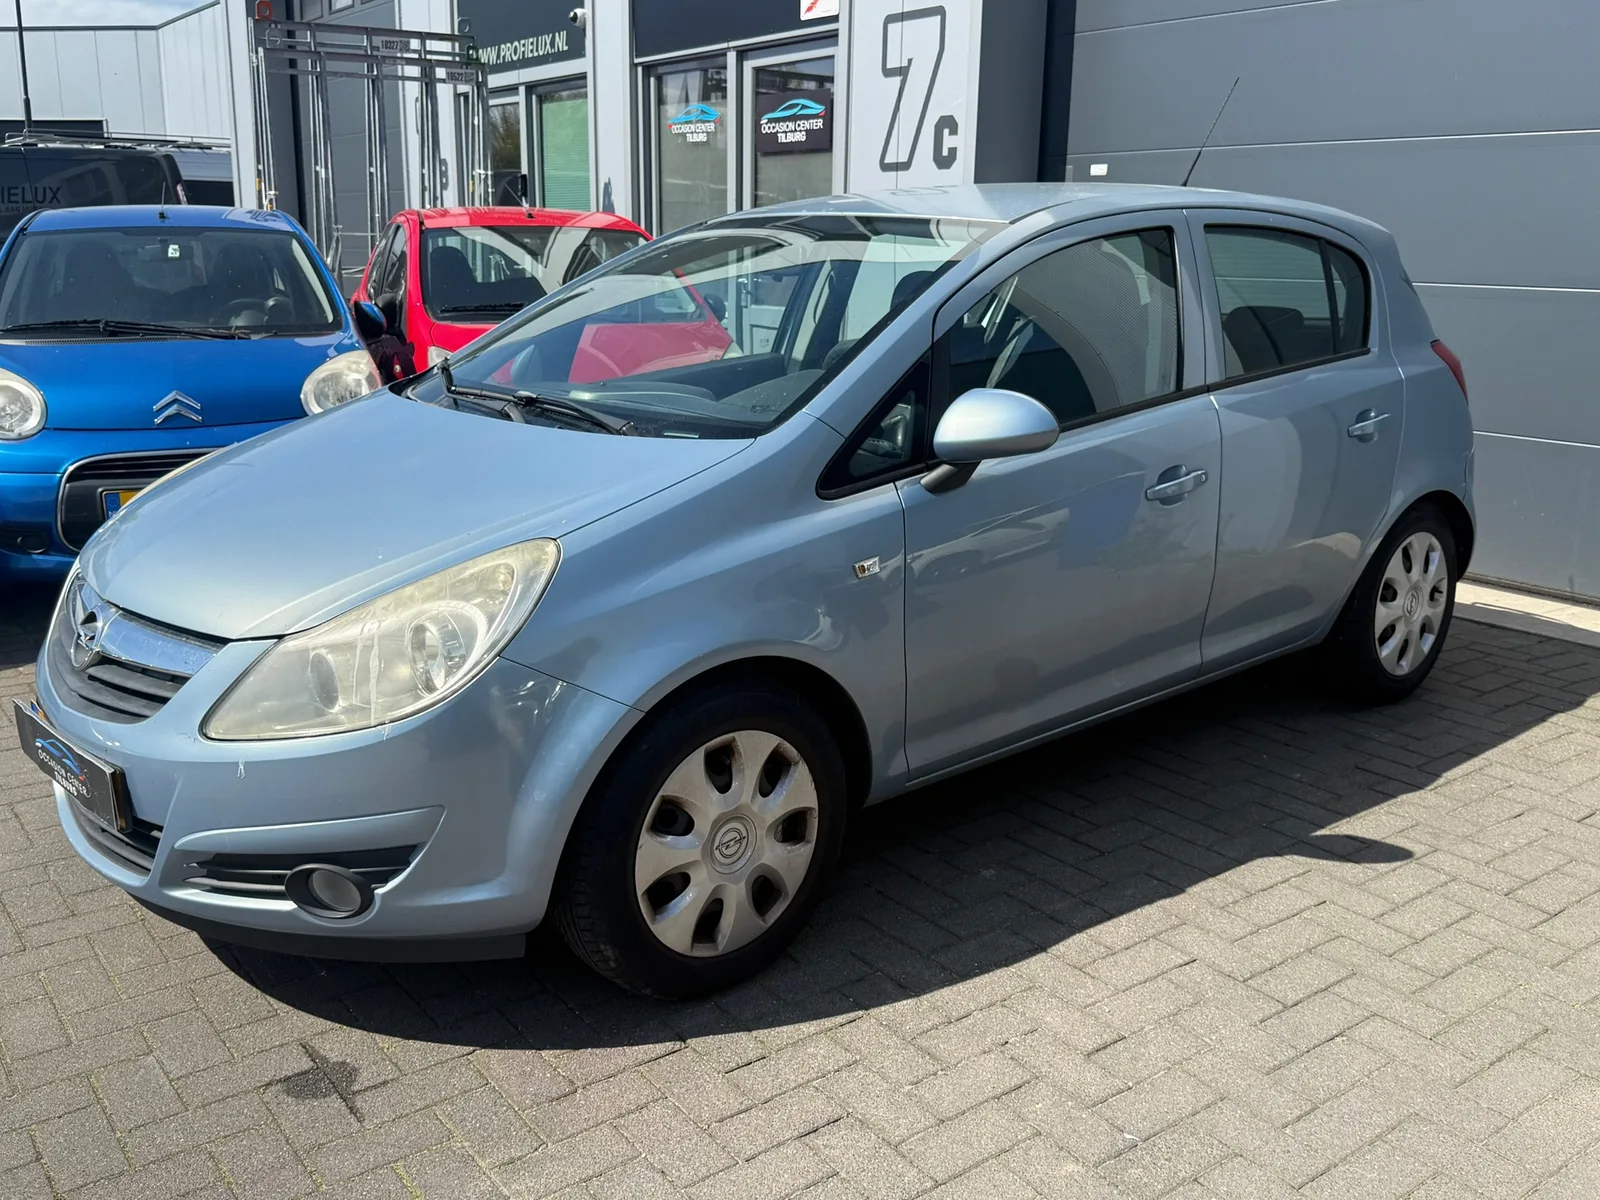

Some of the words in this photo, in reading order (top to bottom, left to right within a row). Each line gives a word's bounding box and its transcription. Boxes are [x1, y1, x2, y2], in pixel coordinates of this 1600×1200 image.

[671, 123, 695, 134] OCCASION
[695, 122, 715, 132] CENTER
[761, 120, 795, 134] OCCASION
[796, 119, 823, 131] CENTER
[686, 133, 707, 143] TILBURG
[777, 132, 806, 143] TILBURG
[38, 749, 66, 778] OCCASION
[67, 772, 87, 796] CENTER
[54, 771, 77, 796] TILBURG
